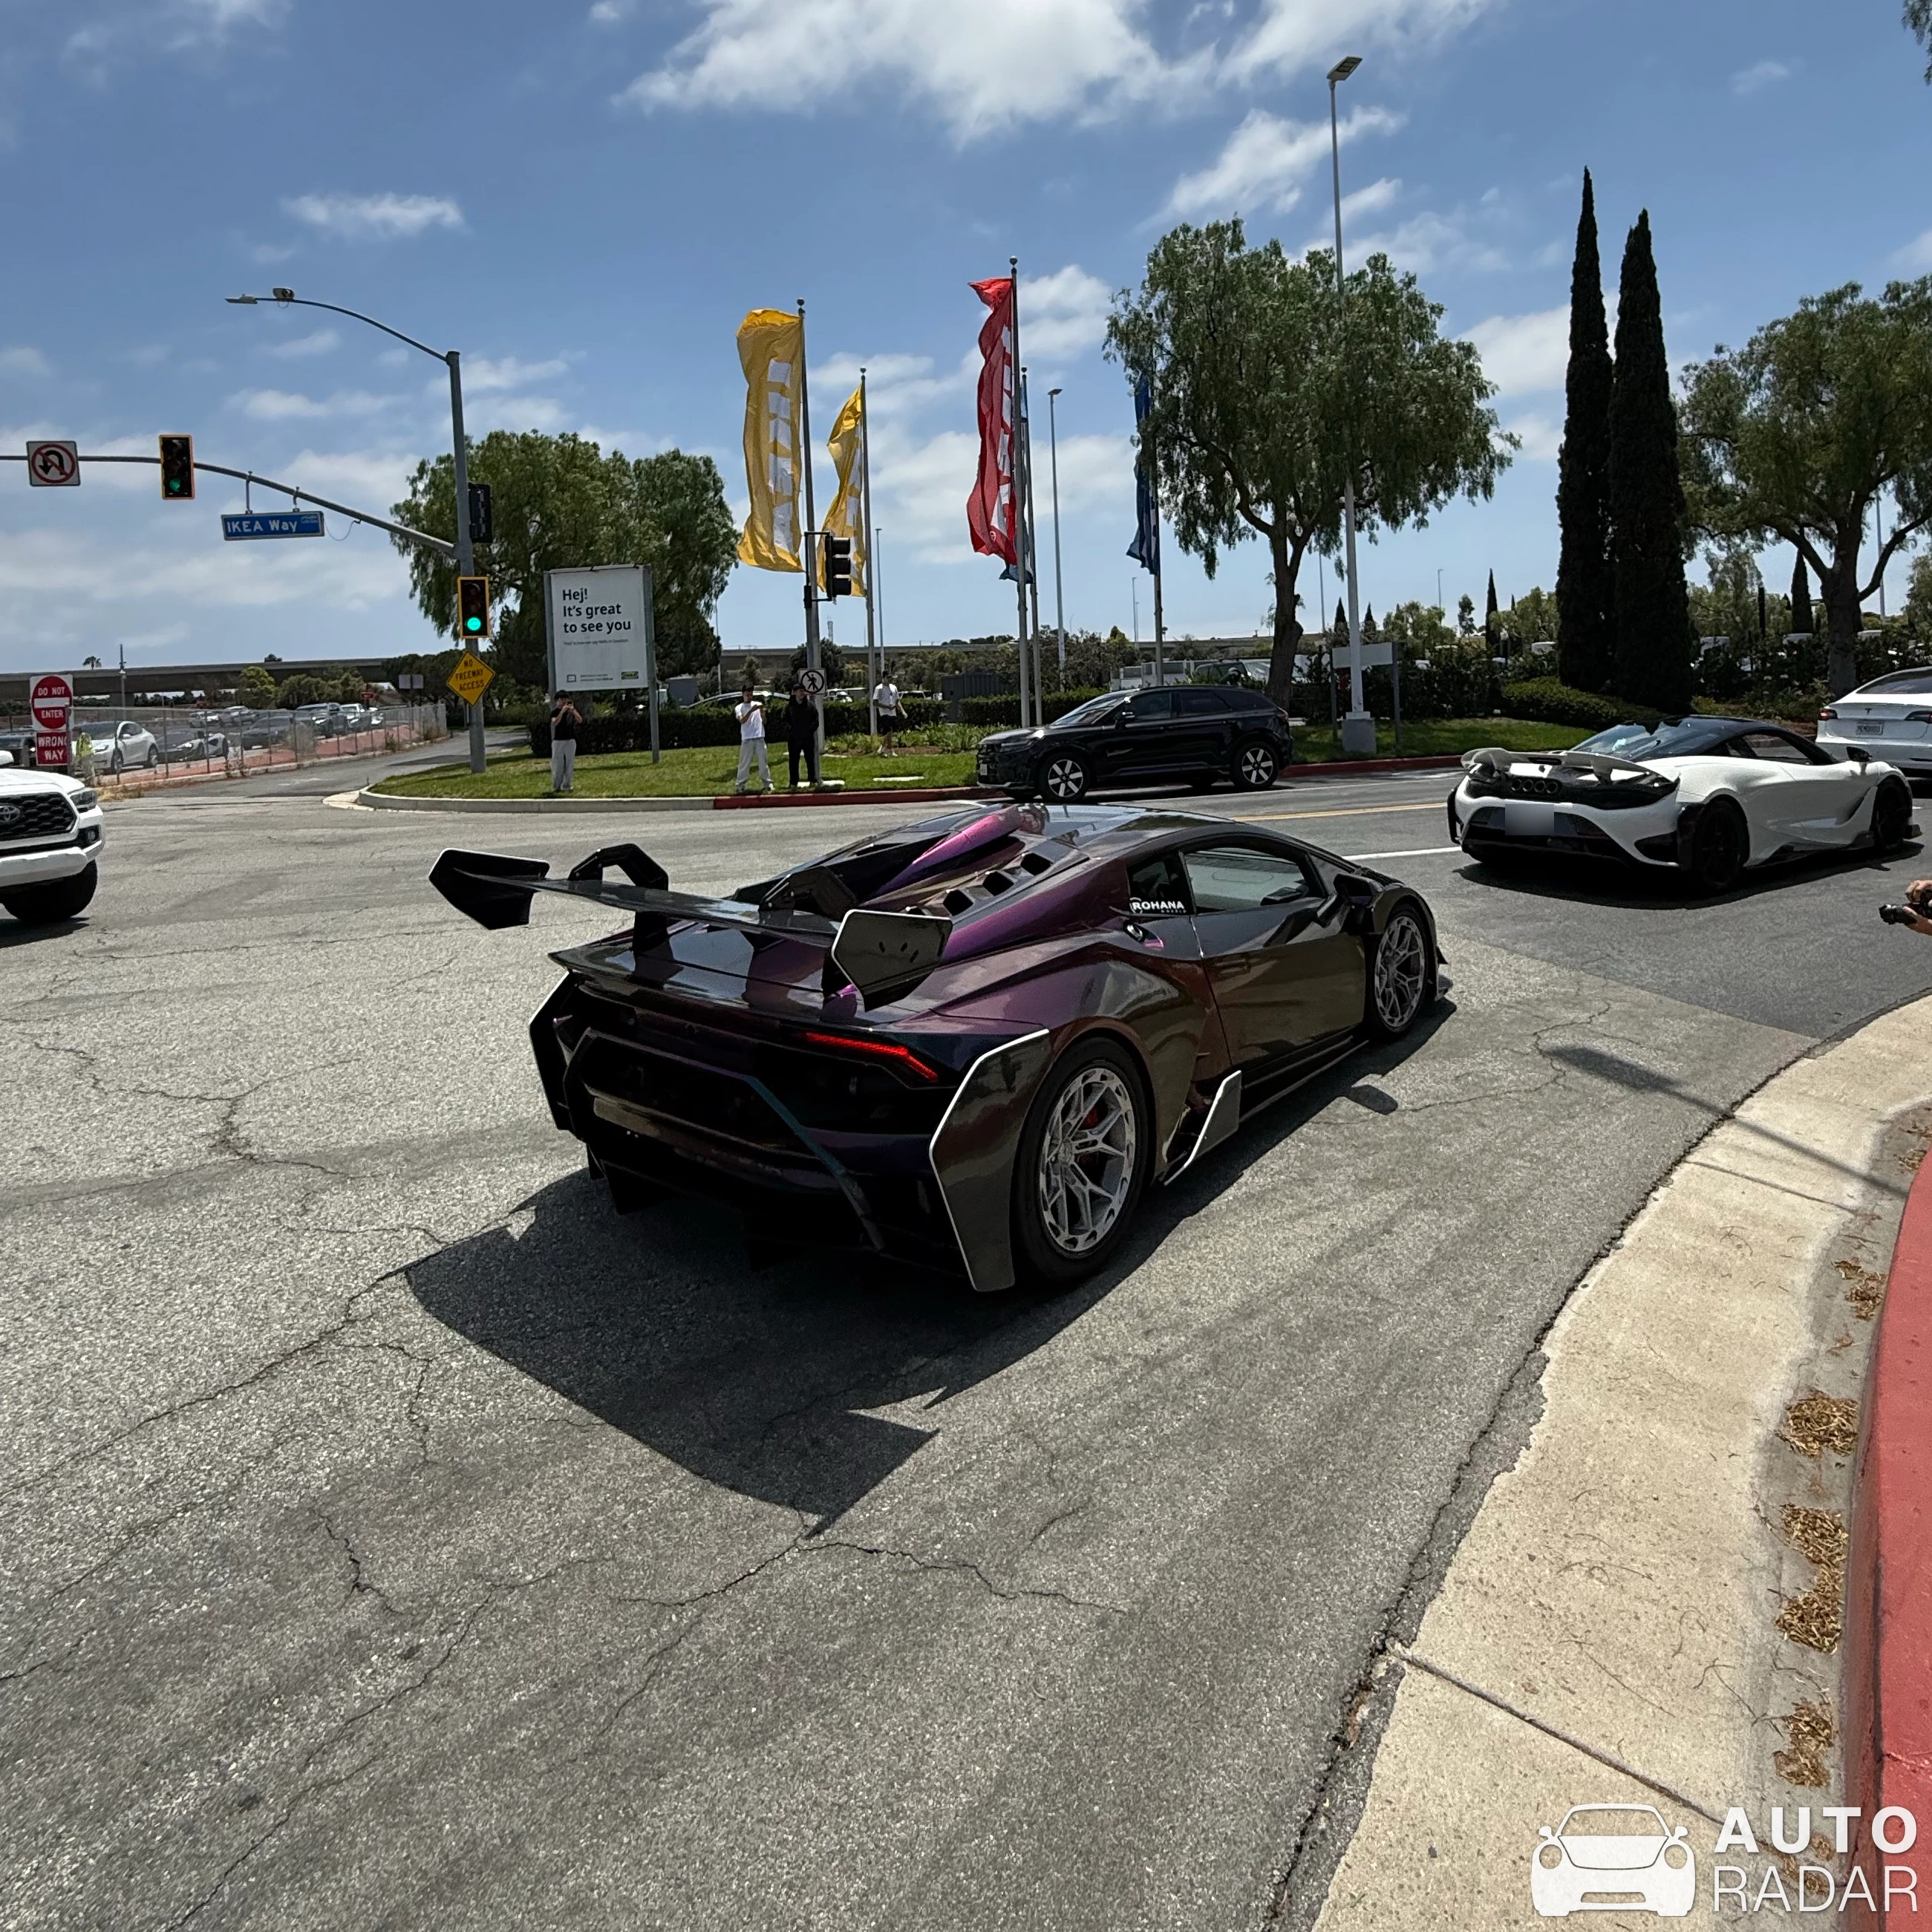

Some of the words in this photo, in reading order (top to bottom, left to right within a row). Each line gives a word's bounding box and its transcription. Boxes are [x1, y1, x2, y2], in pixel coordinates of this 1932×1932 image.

[226, 520, 264, 533] IKEA
[269, 520, 298, 532] Way
[562, 587, 588, 604] Hej!
[563, 605, 582, 617] It's
[586, 603, 622, 619] great
[564, 622, 578, 633] to
[581, 622, 603, 633] see
[606, 621, 631, 634] you
[463, 659, 473, 668] NO
[455, 669, 483, 681] FREEWAY
[459, 679, 485, 691] ACCESS
[38, 688, 48, 696] DO
[51, 687, 65, 696] NOT
[41, 709, 64, 719] ENTER
[45, 750, 64, 760] WAY
[1132, 901, 1185, 910] ROHANA
